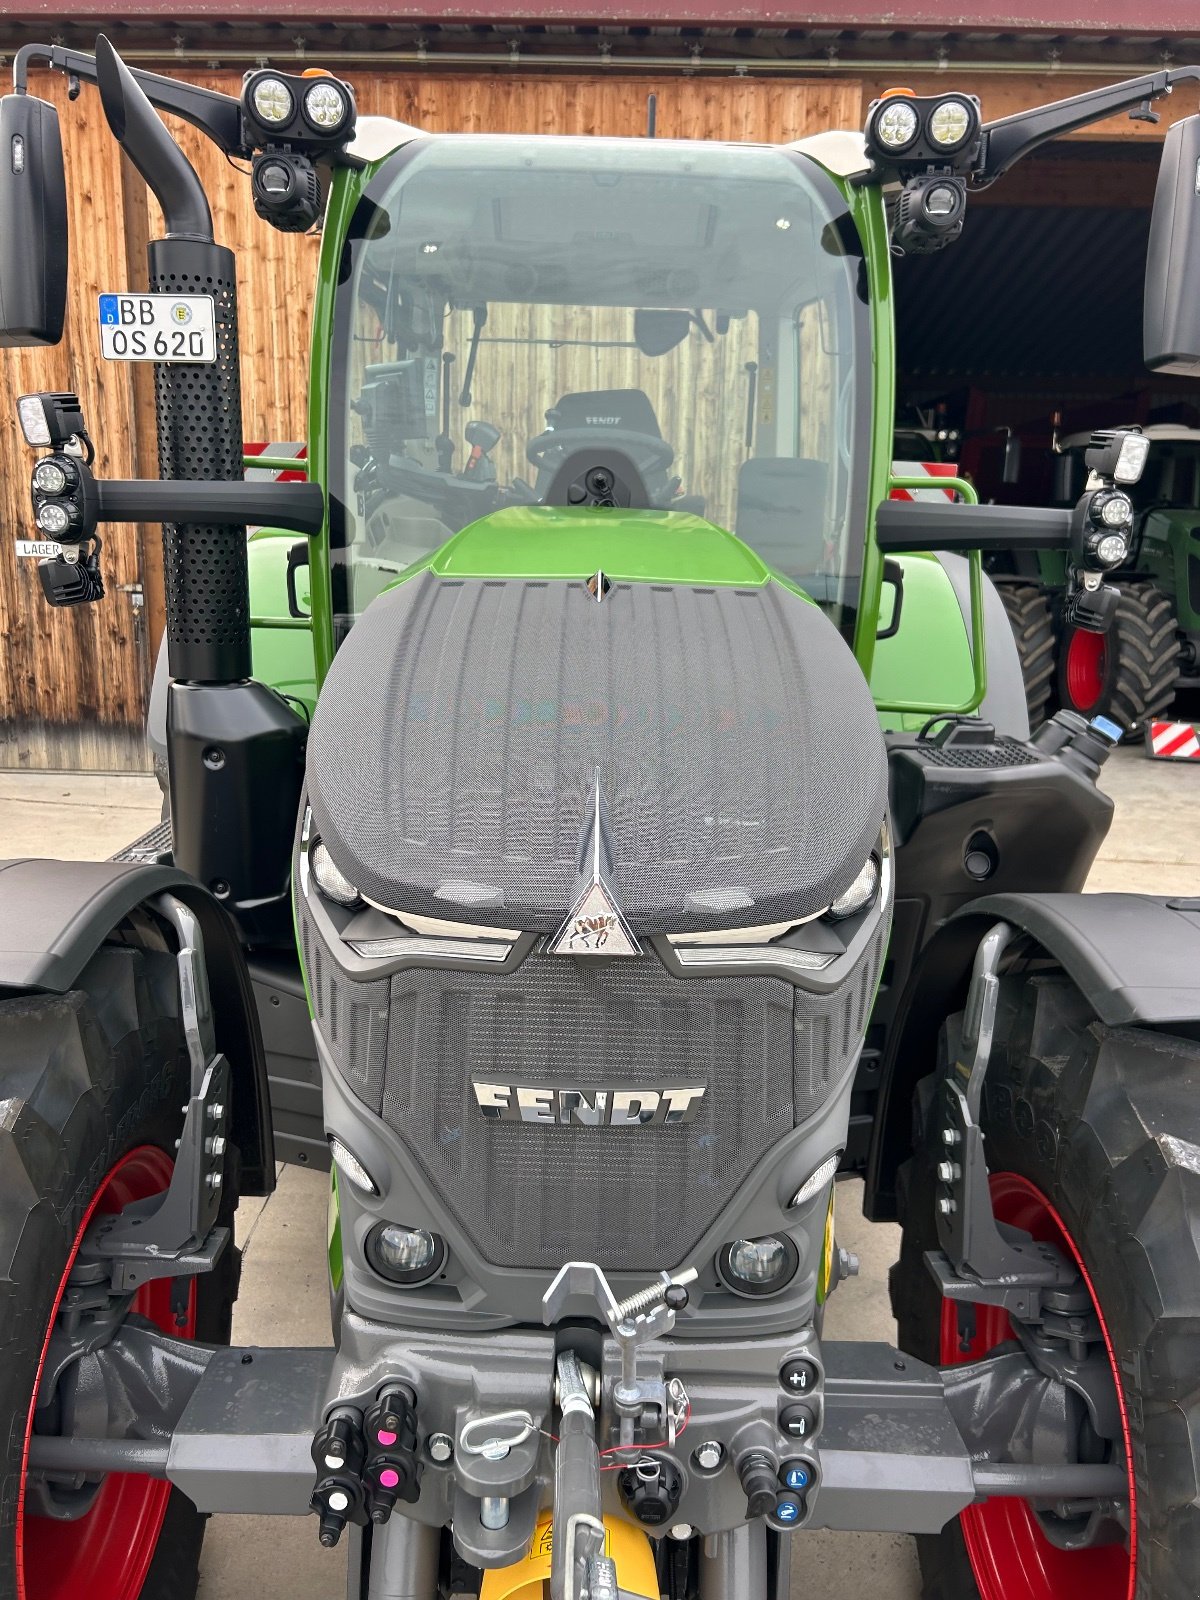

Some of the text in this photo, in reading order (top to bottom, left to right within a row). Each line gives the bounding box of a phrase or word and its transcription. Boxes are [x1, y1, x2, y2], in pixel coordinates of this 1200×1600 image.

[107, 314, 114, 323] D
[120, 299, 155, 326] BB
[585, 416, 621, 425] FENDT
[23, 543, 60, 555] LAGER
[472, 1082, 706, 1126] FENDT
